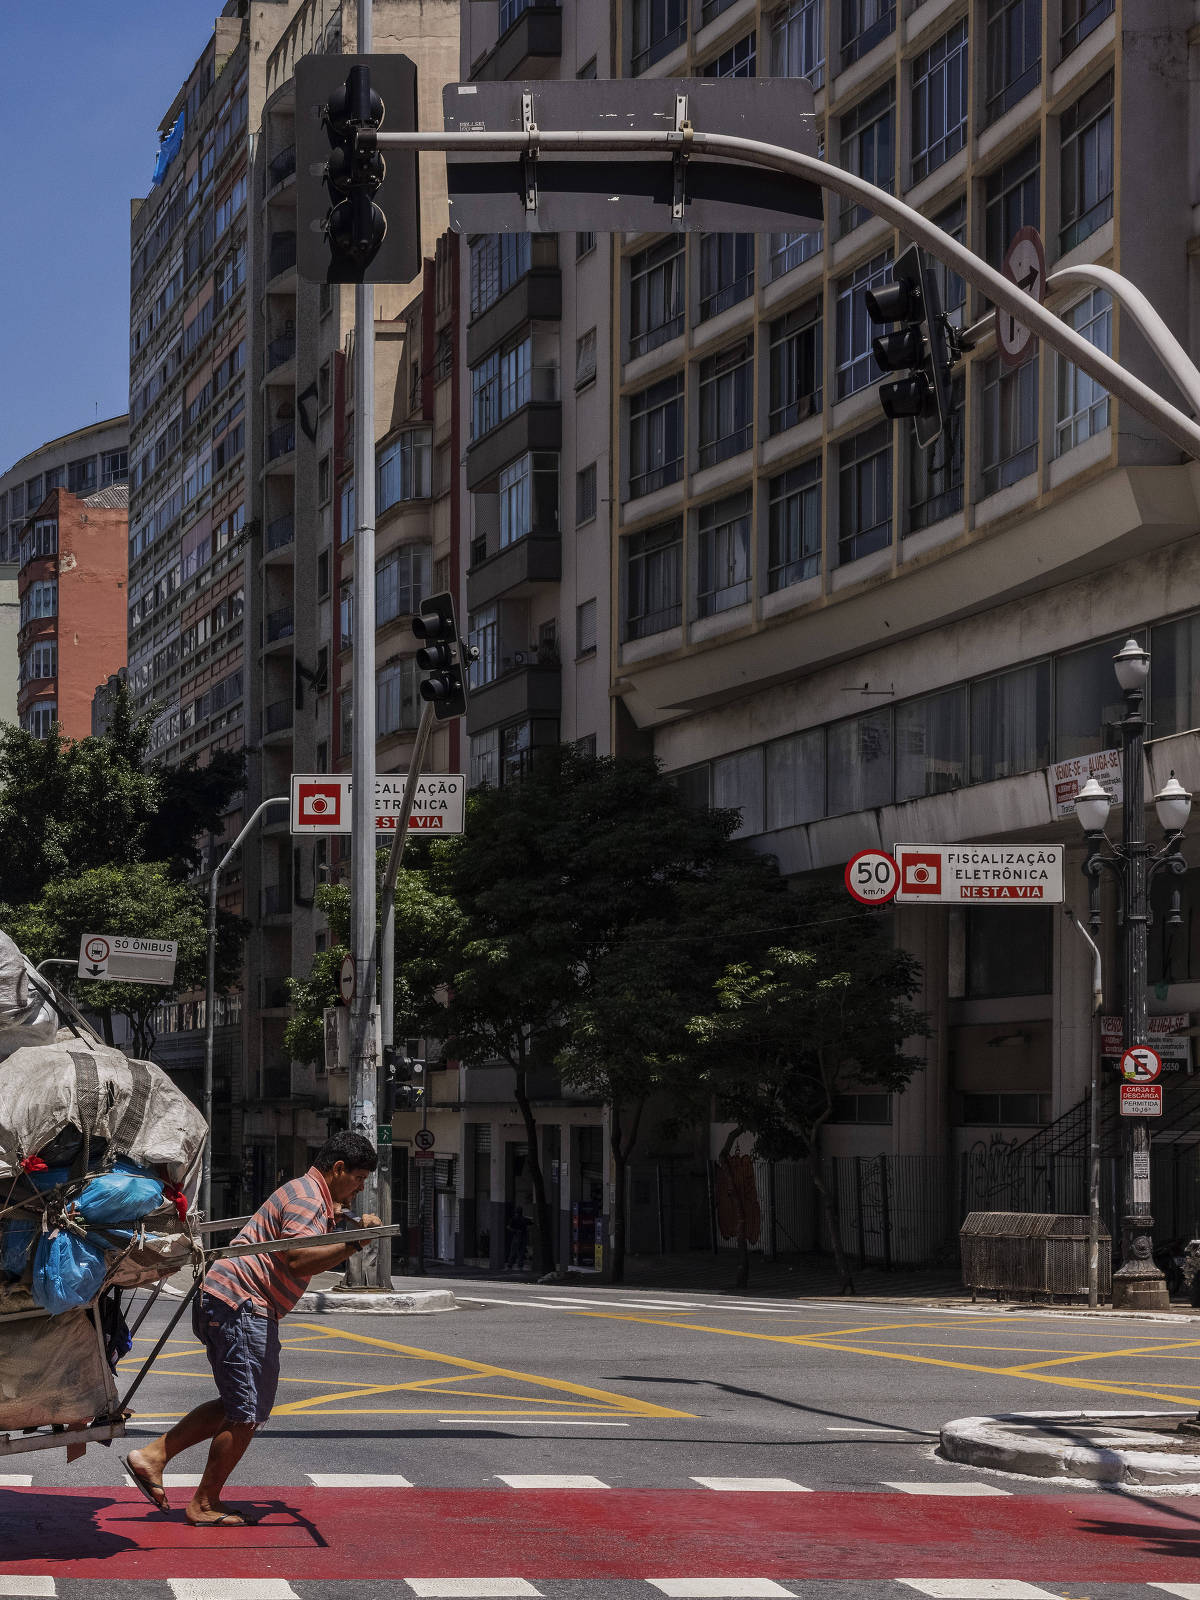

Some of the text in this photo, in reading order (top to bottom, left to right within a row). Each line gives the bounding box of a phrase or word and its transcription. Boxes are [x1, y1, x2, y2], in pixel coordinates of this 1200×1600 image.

[1088, 752, 1118, 772] ALUGA-SE
[347, 781, 457, 796] FCALIAÇÃO
[375, 799, 448, 810] ETRNICA
[375, 817, 441, 828] EST VIA
[948, 851, 1056, 867] FISCALIZAÇÃO
[857, 861, 890, 884] 50
[955, 866, 1049, 880] ELETRÔNICA
[863, 887, 886, 896] km/h
[961, 887, 1041, 897] NESTA VIA
[114, 937, 173, 953] SÓ ÔNIBUS
